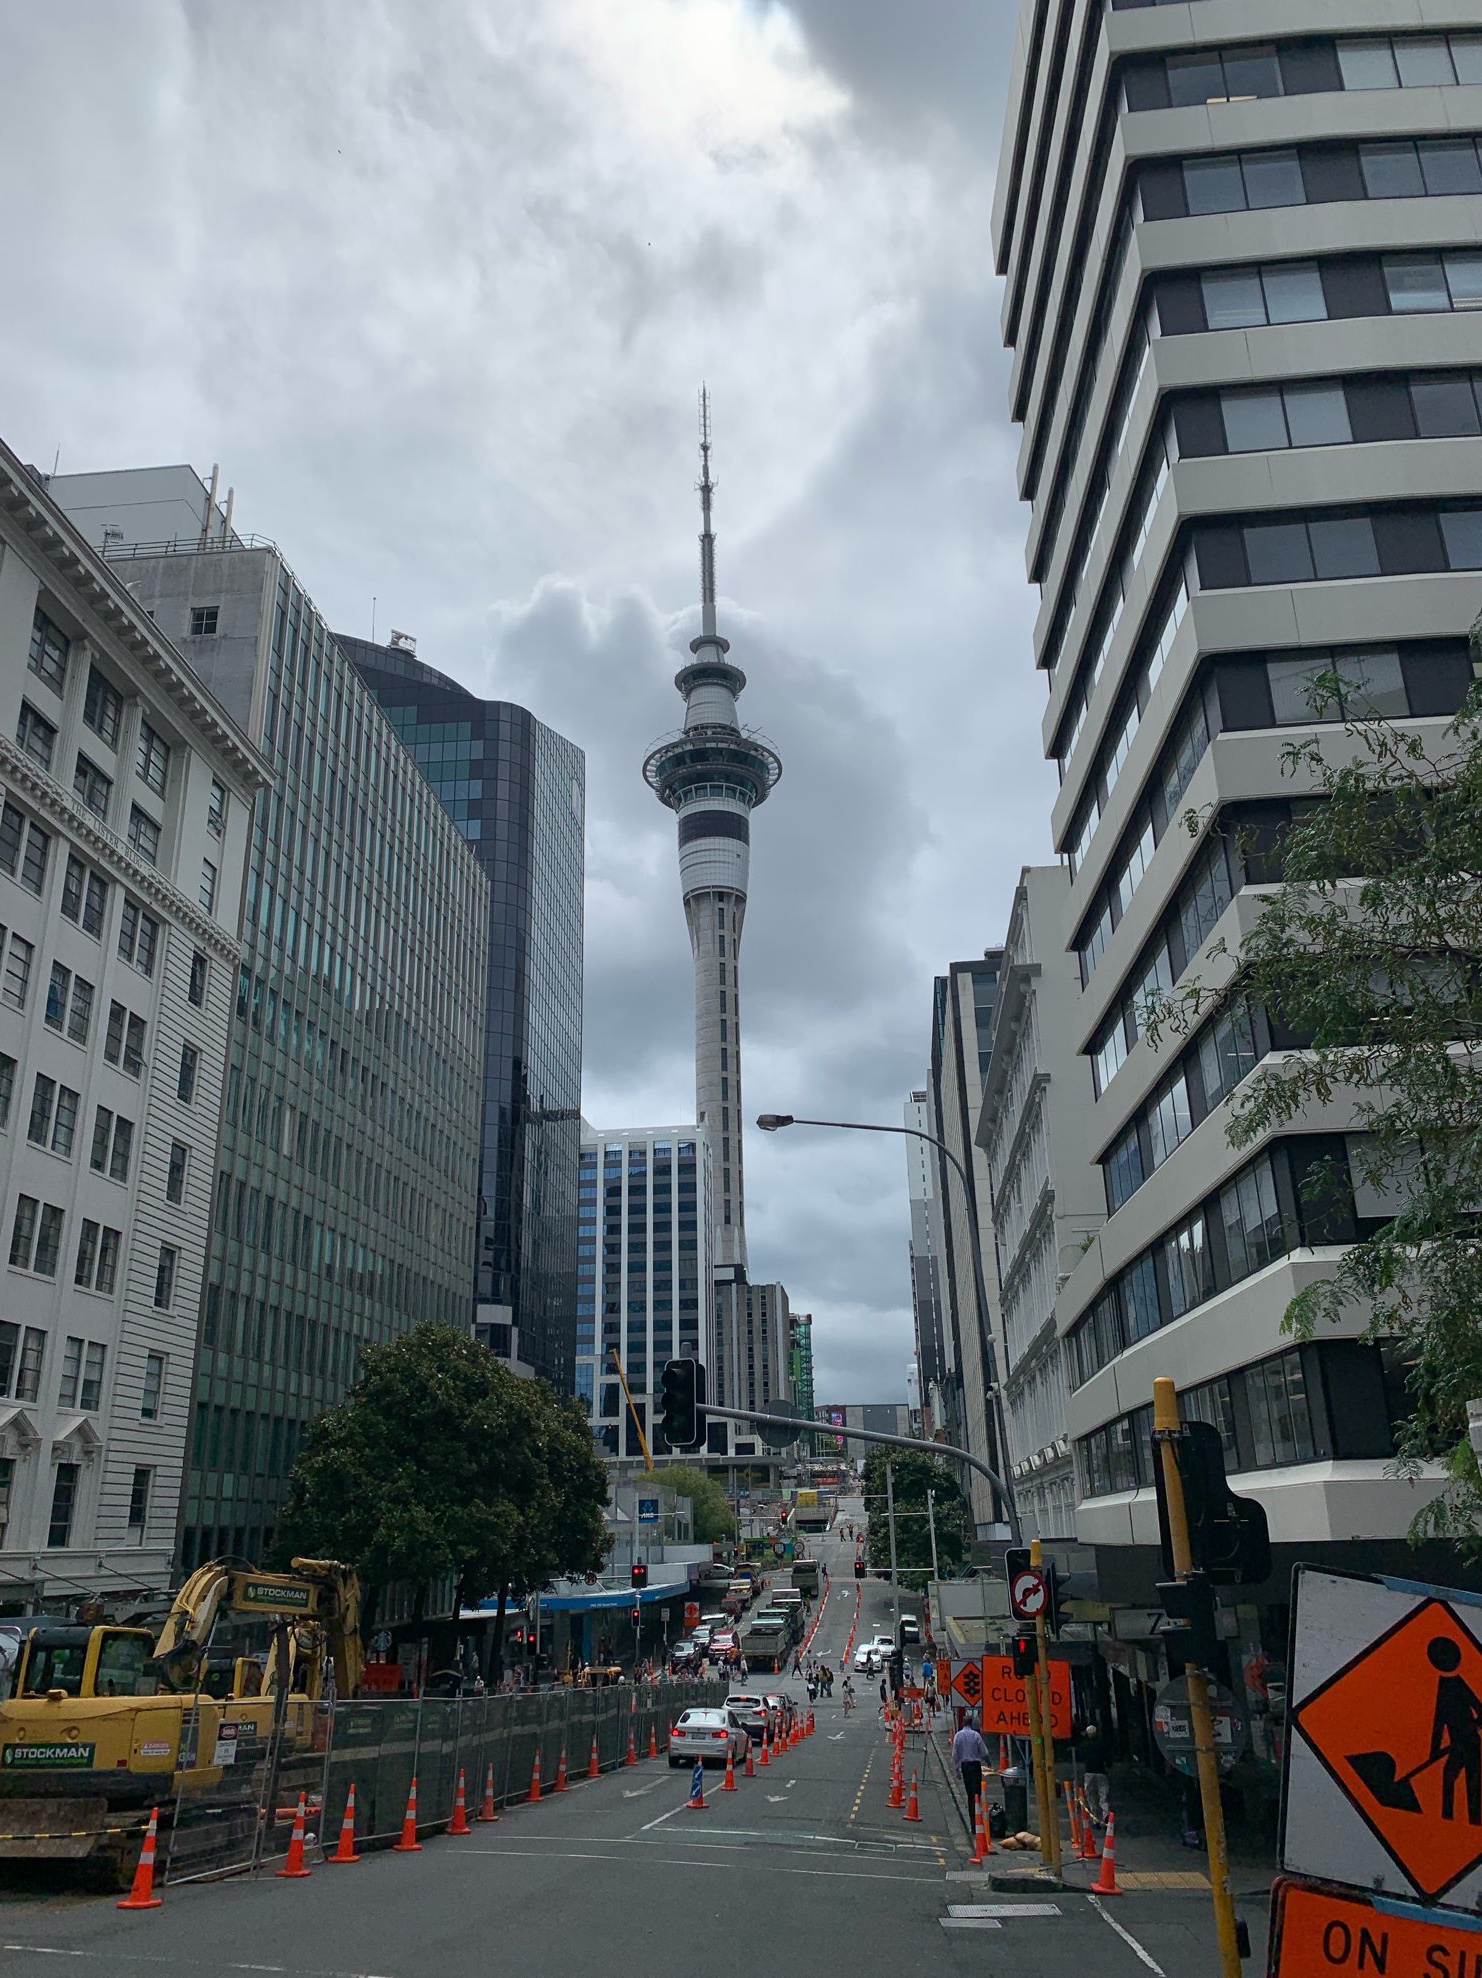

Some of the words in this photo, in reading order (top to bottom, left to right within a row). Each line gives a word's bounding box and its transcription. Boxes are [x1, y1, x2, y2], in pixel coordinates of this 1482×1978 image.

[71, 803, 87, 820] THE
[93, 820, 119, 849] LISTER
[257, 1587, 307, 1599] STOCKMAN
[991, 1687, 1063, 1706] CLOD
[996, 1711, 1059, 1729] AHED
[14, 1747, 90, 1759] STOCKMAN
[1323, 1919, 1389, 1975] ON
[1423, 1943, 1482, 1978] SI
